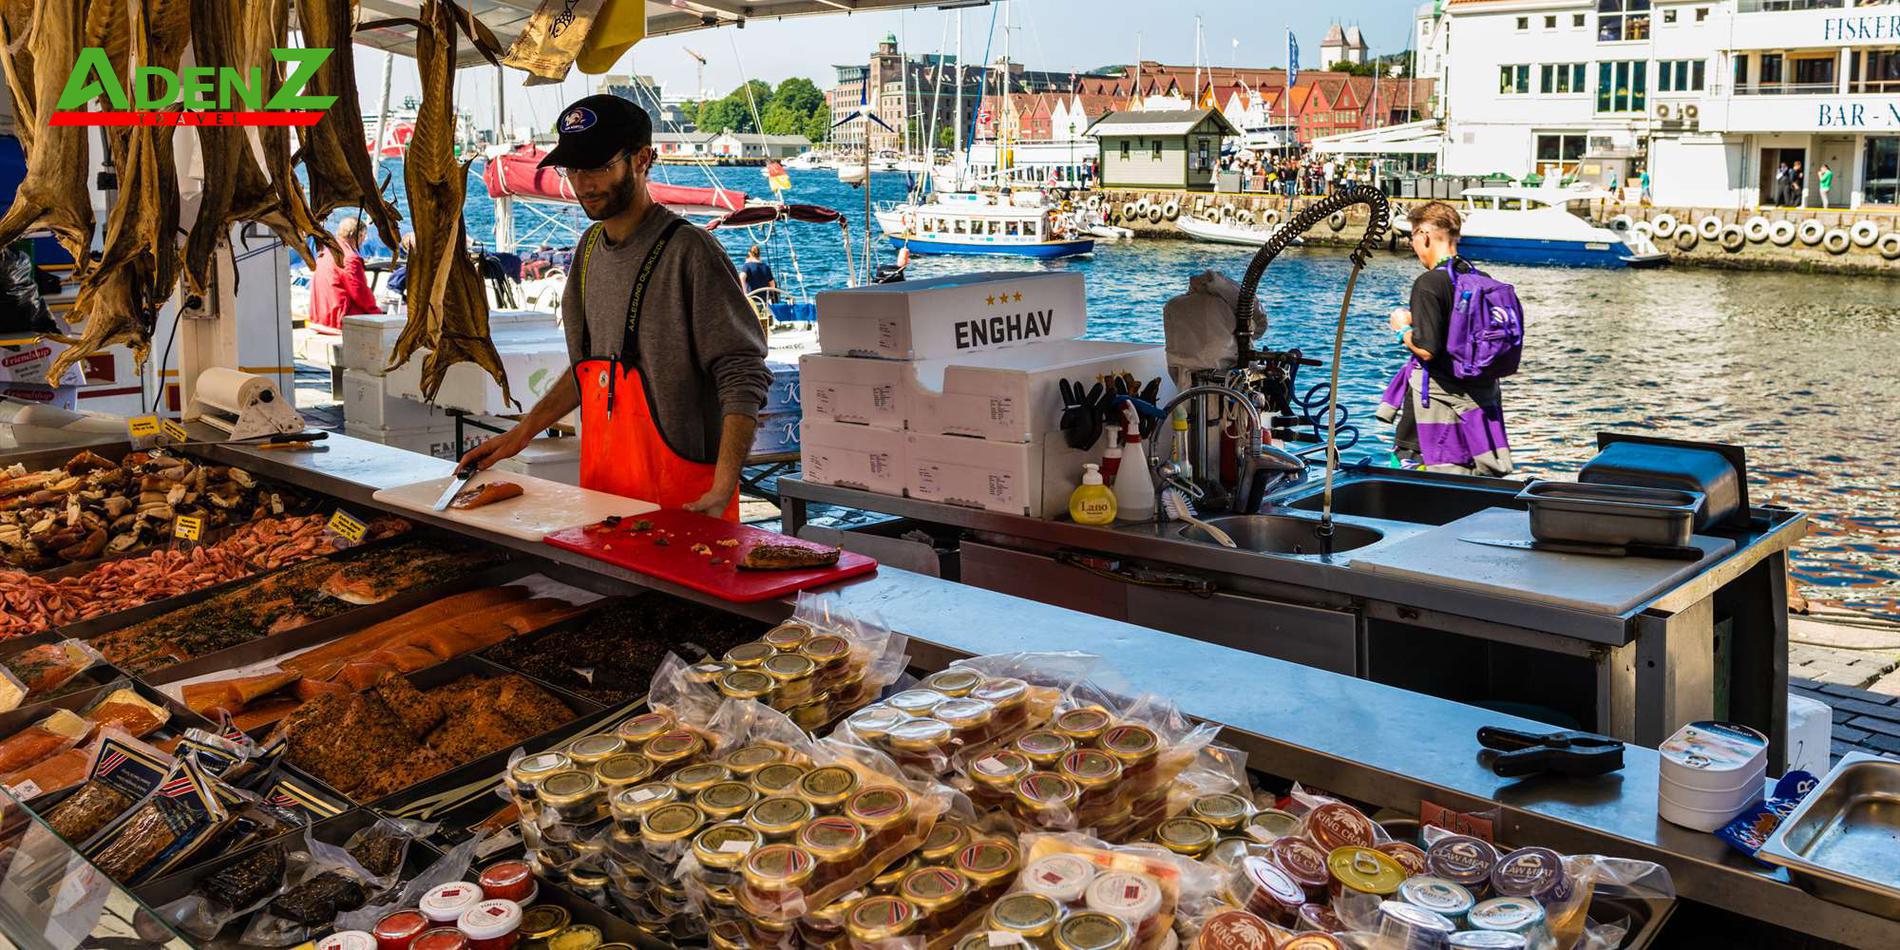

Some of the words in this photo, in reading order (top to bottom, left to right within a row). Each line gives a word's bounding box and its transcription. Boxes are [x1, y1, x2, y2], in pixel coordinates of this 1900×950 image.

[1818, 103, 1865, 127] BAR
[628, 283, 643, 332] AALESUND
[955, 309, 1054, 350] ENGHAV
[1081, 501, 1108, 512] Lano
[1315, 811, 1340, 832] KING
[1432, 849, 1462, 866] CLAW
[1462, 855, 1490, 870] MEAT
[1209, 921, 1236, 946] KING
